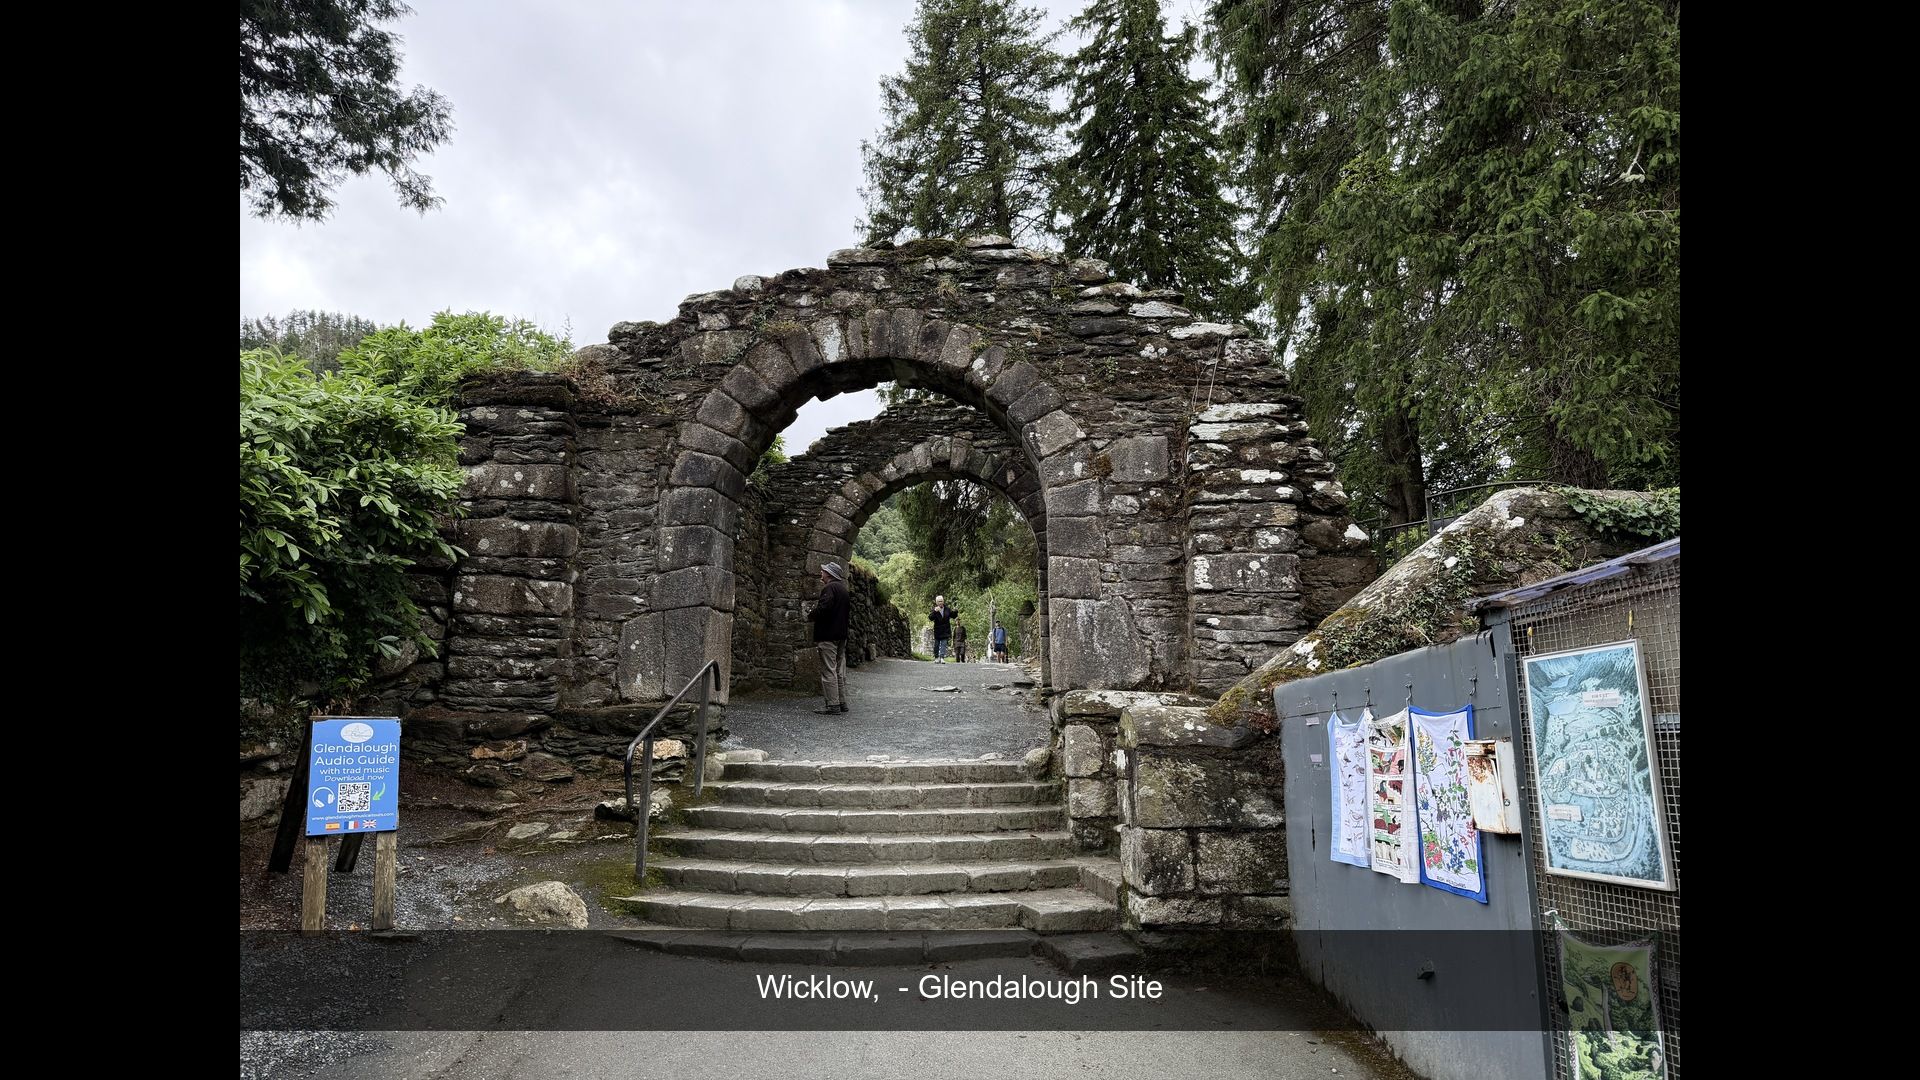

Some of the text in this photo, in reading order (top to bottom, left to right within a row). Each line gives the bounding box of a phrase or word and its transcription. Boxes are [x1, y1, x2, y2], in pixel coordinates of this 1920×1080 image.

[313, 742, 397, 754] Glendalough
[314, 754, 396, 766] Audio Guide
[319, 766, 390, 775] with trad music
[324, 774, 365, 782] Download
